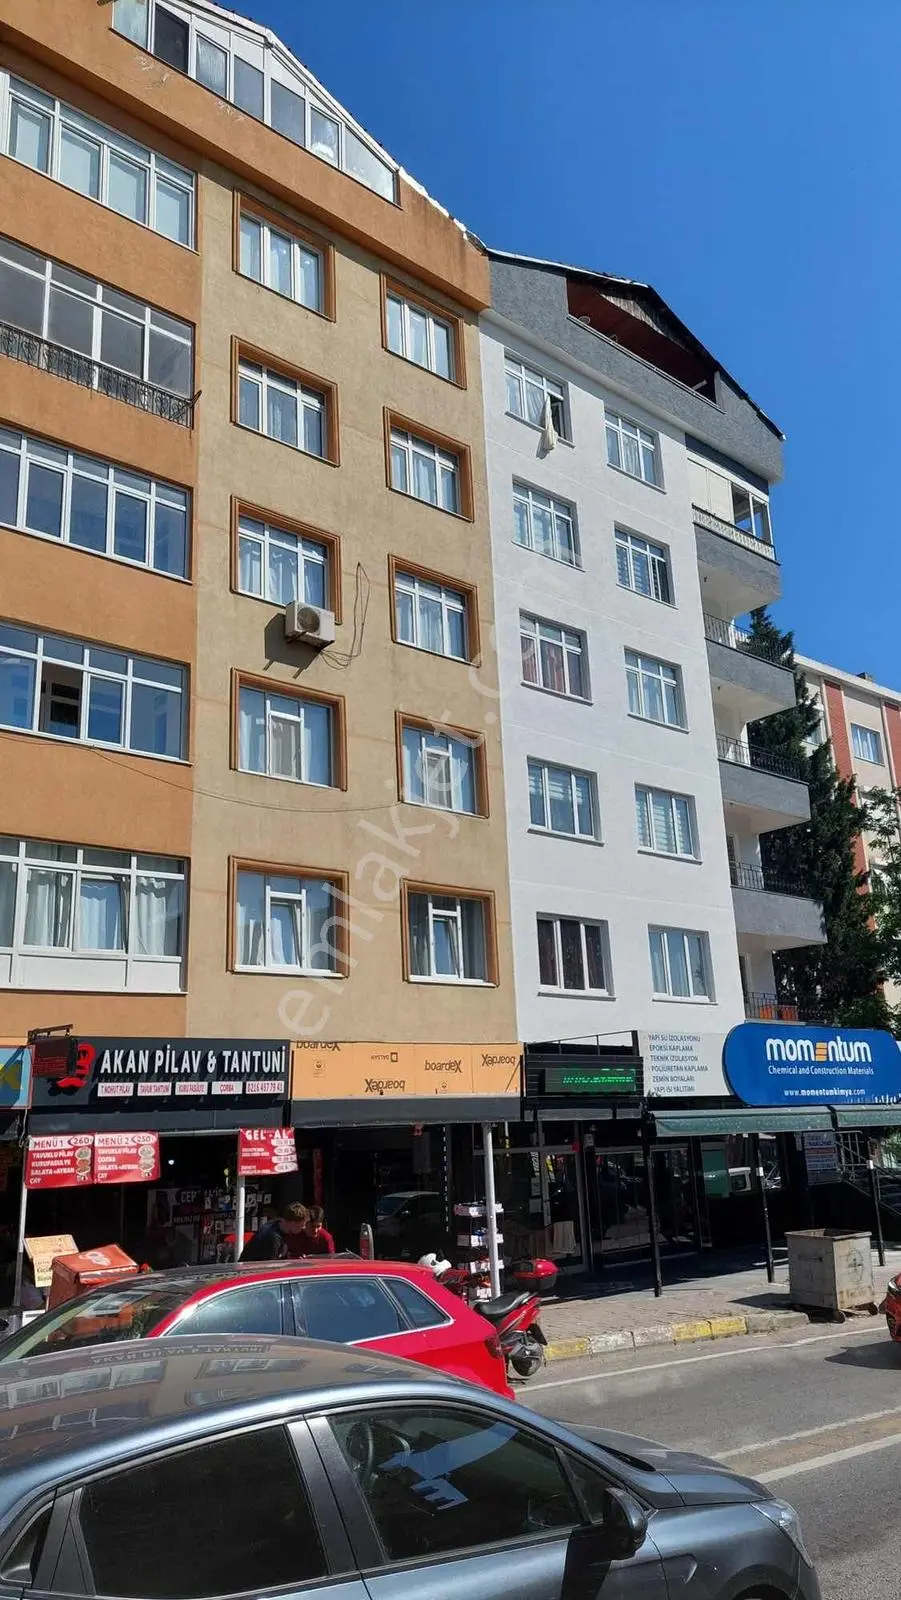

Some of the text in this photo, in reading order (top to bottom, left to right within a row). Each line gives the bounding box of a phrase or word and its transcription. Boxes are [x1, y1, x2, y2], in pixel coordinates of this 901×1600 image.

[100, 1044, 285, 1074] AKAN PİLAV & TANTUNİ
[424, 1060, 462, 1073] boardeX
[768, 1065, 874, 1075] Chemical and Construction Materials
[784, 1088, 866, 1096] www.momentumkimya.com
